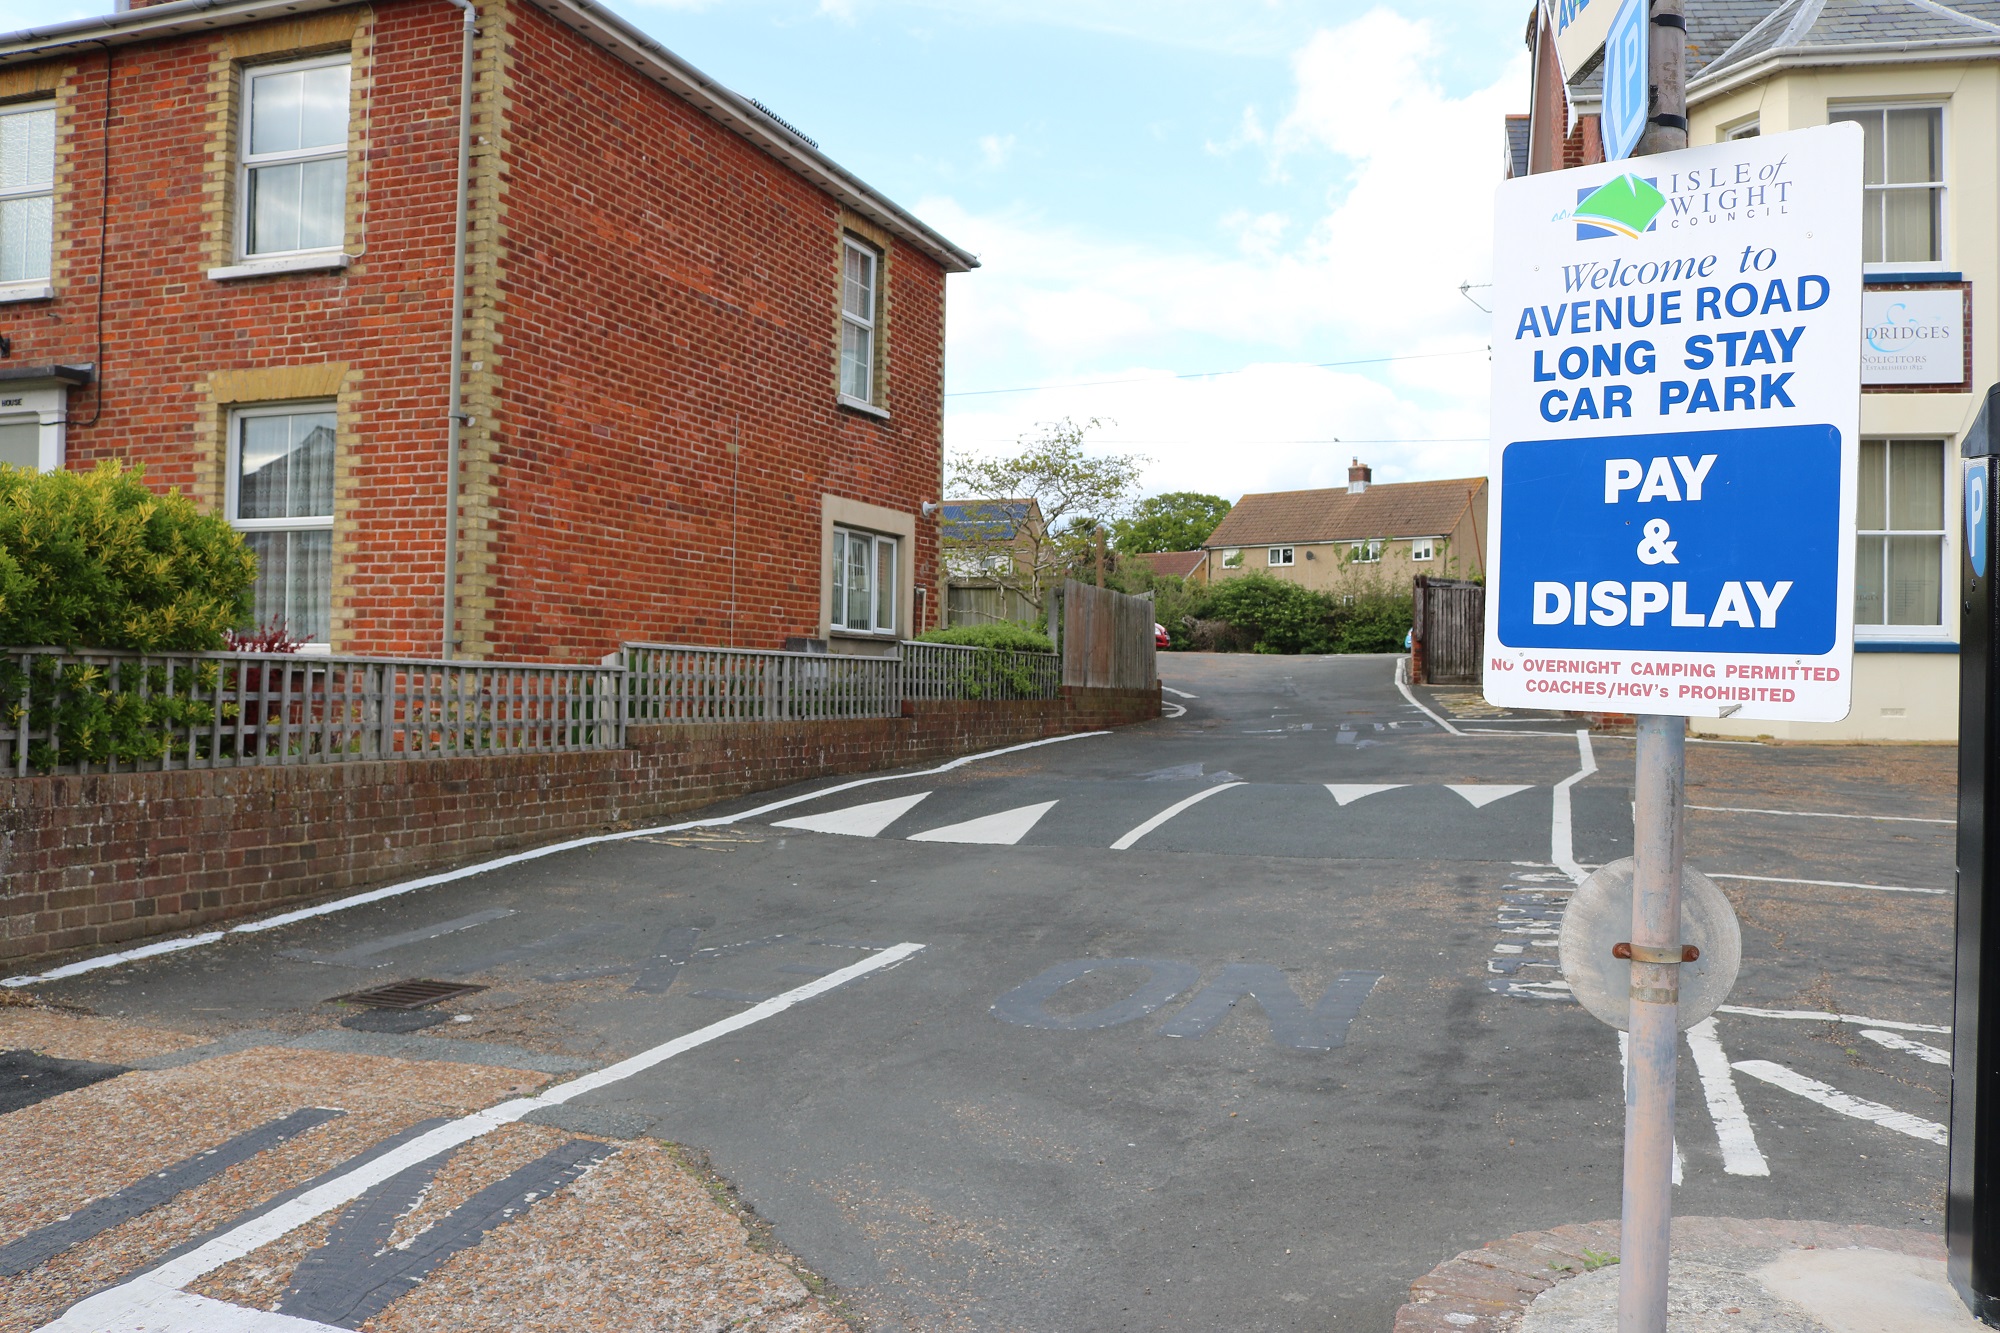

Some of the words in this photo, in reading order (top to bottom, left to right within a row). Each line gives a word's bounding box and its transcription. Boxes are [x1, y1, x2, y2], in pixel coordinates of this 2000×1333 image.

[1671, 163, 1751, 193] ISLE
[1759, 154, 1787, 186] of
[1669, 181, 1792, 218] WIGHT
[1672, 206, 1787, 228] COUNCIL
[1562, 255, 1717, 293] Welcome
[1740, 246, 1776, 273] to
[1515, 291, 1681, 340] AVENUE
[1696, 275, 1830, 321] ROAD
[1534, 340, 1656, 382] LONG
[1684, 326, 1806, 370] STAY
[2, 399, 22, 407] HOUSE
[1540, 385, 1632, 423] CAR
[1660, 372, 1796, 415] PARK
[1605, 455, 1717, 503] PAY
[1637, 519, 1679, 564] &
[1533, 581, 1793, 628] DISPLAY
[1492, 659, 1514, 671] NO
[1523, 659, 1621, 674] OVERNIGHT
[1631, 662, 1715, 677] CAMPING
[1726, 663, 1840, 681] PERMITTED
[1526, 679, 1668, 698] COACHES/HGV's
[1679, 685, 1795, 702] PROHIBITED
